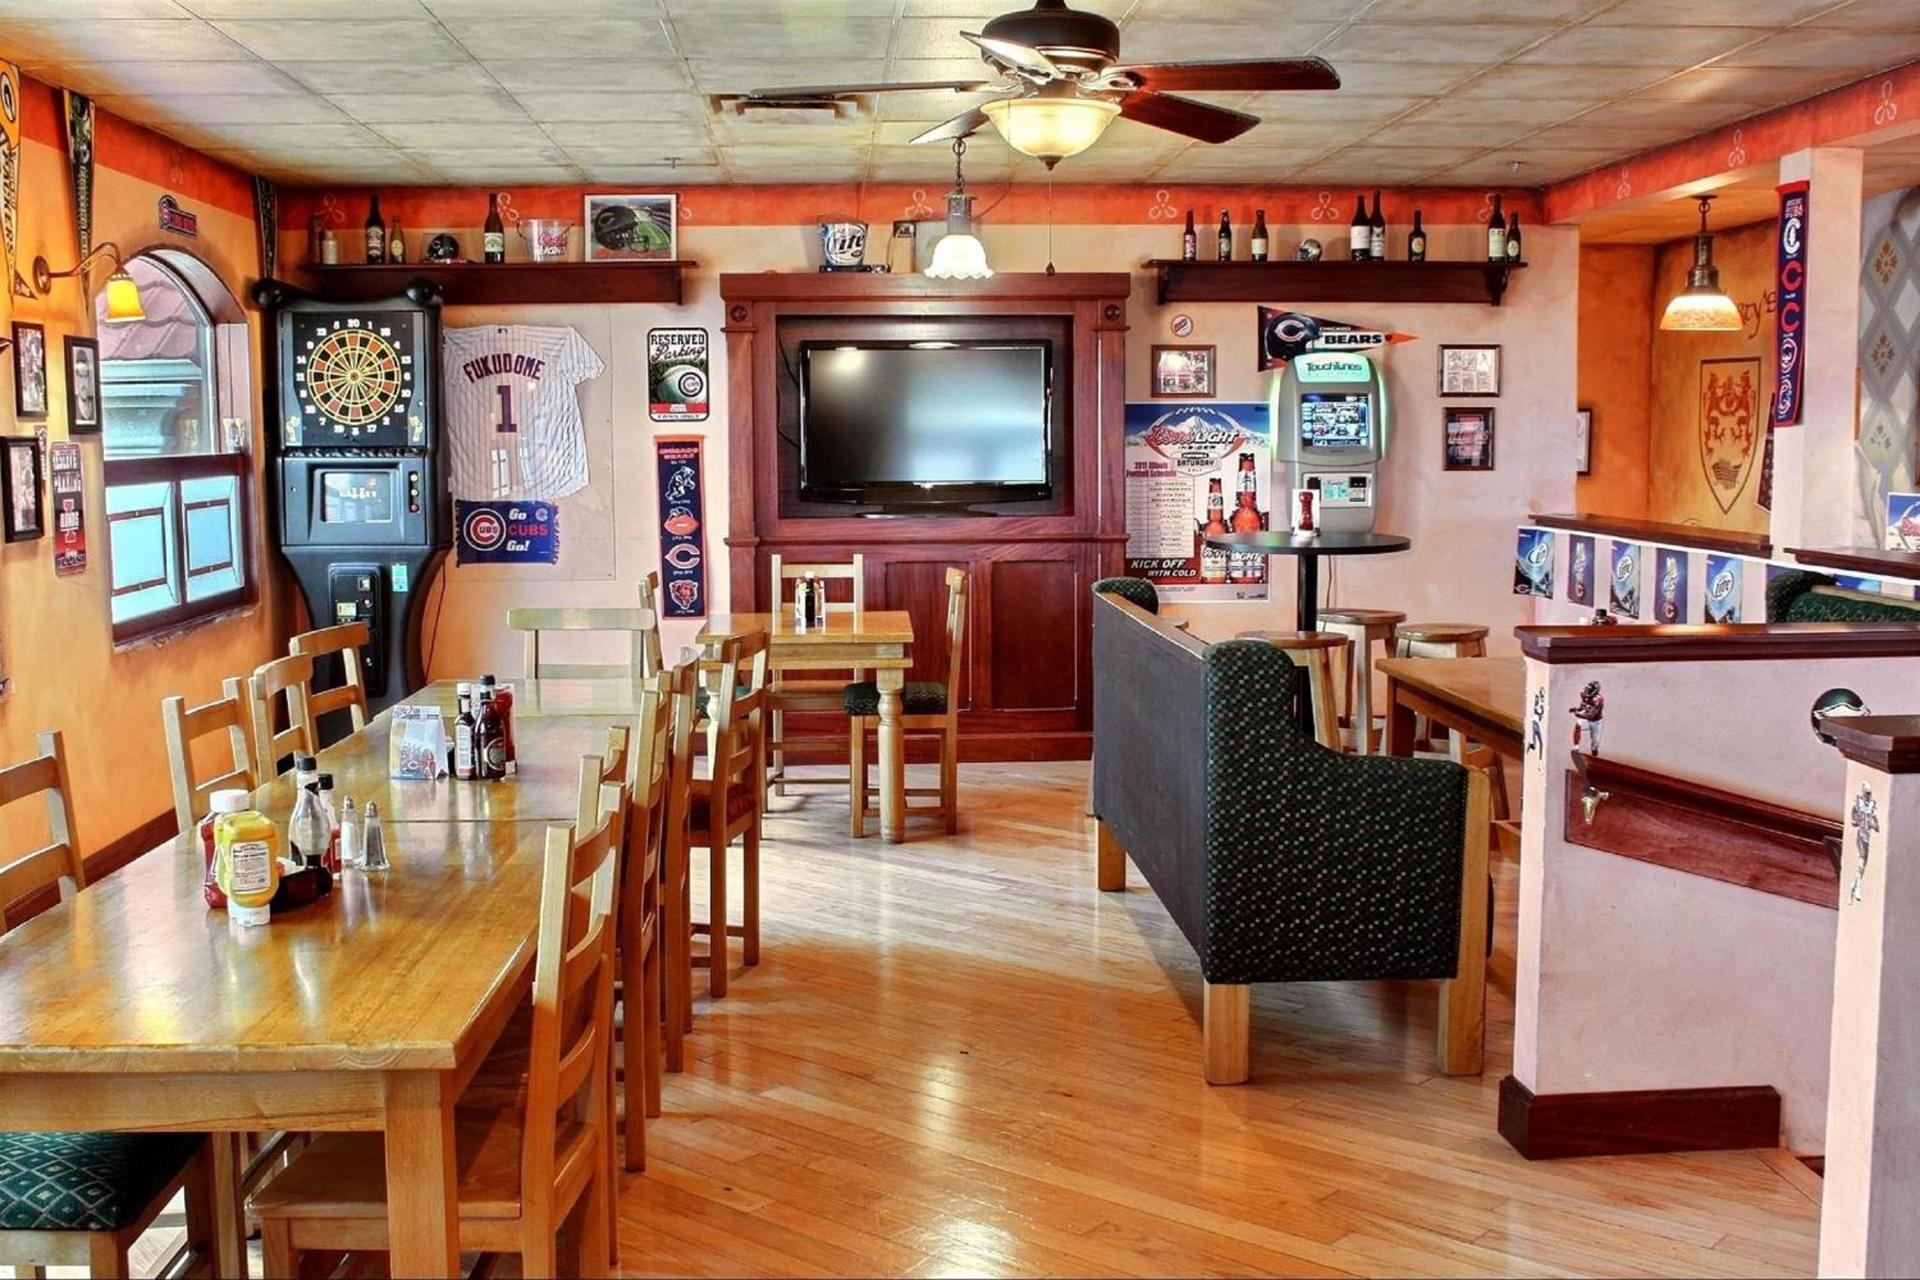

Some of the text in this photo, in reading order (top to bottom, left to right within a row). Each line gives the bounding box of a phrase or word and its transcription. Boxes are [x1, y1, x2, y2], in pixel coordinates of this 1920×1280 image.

[347, 318, 361, 328] 20
[367, 320, 374, 330] 1
[651, 334, 705, 345] RESERVED
[1325, 334, 1382, 345] BEARS
[651, 343, 706, 363] Parking
[462, 353, 545, 384] FUKUDOME
[496, 385, 517, 433] 1
[1152, 425, 1240, 445] Coors LIGHT
[1177, 459, 1215, 467] SATURDAY
[508, 508, 527, 521] Go
[508, 524, 549, 537] CUBS
[506, 539, 532, 552] Go!
[1131, 559, 1187, 569] KICK OFF
[1171, 569, 1197, 577] COLD
